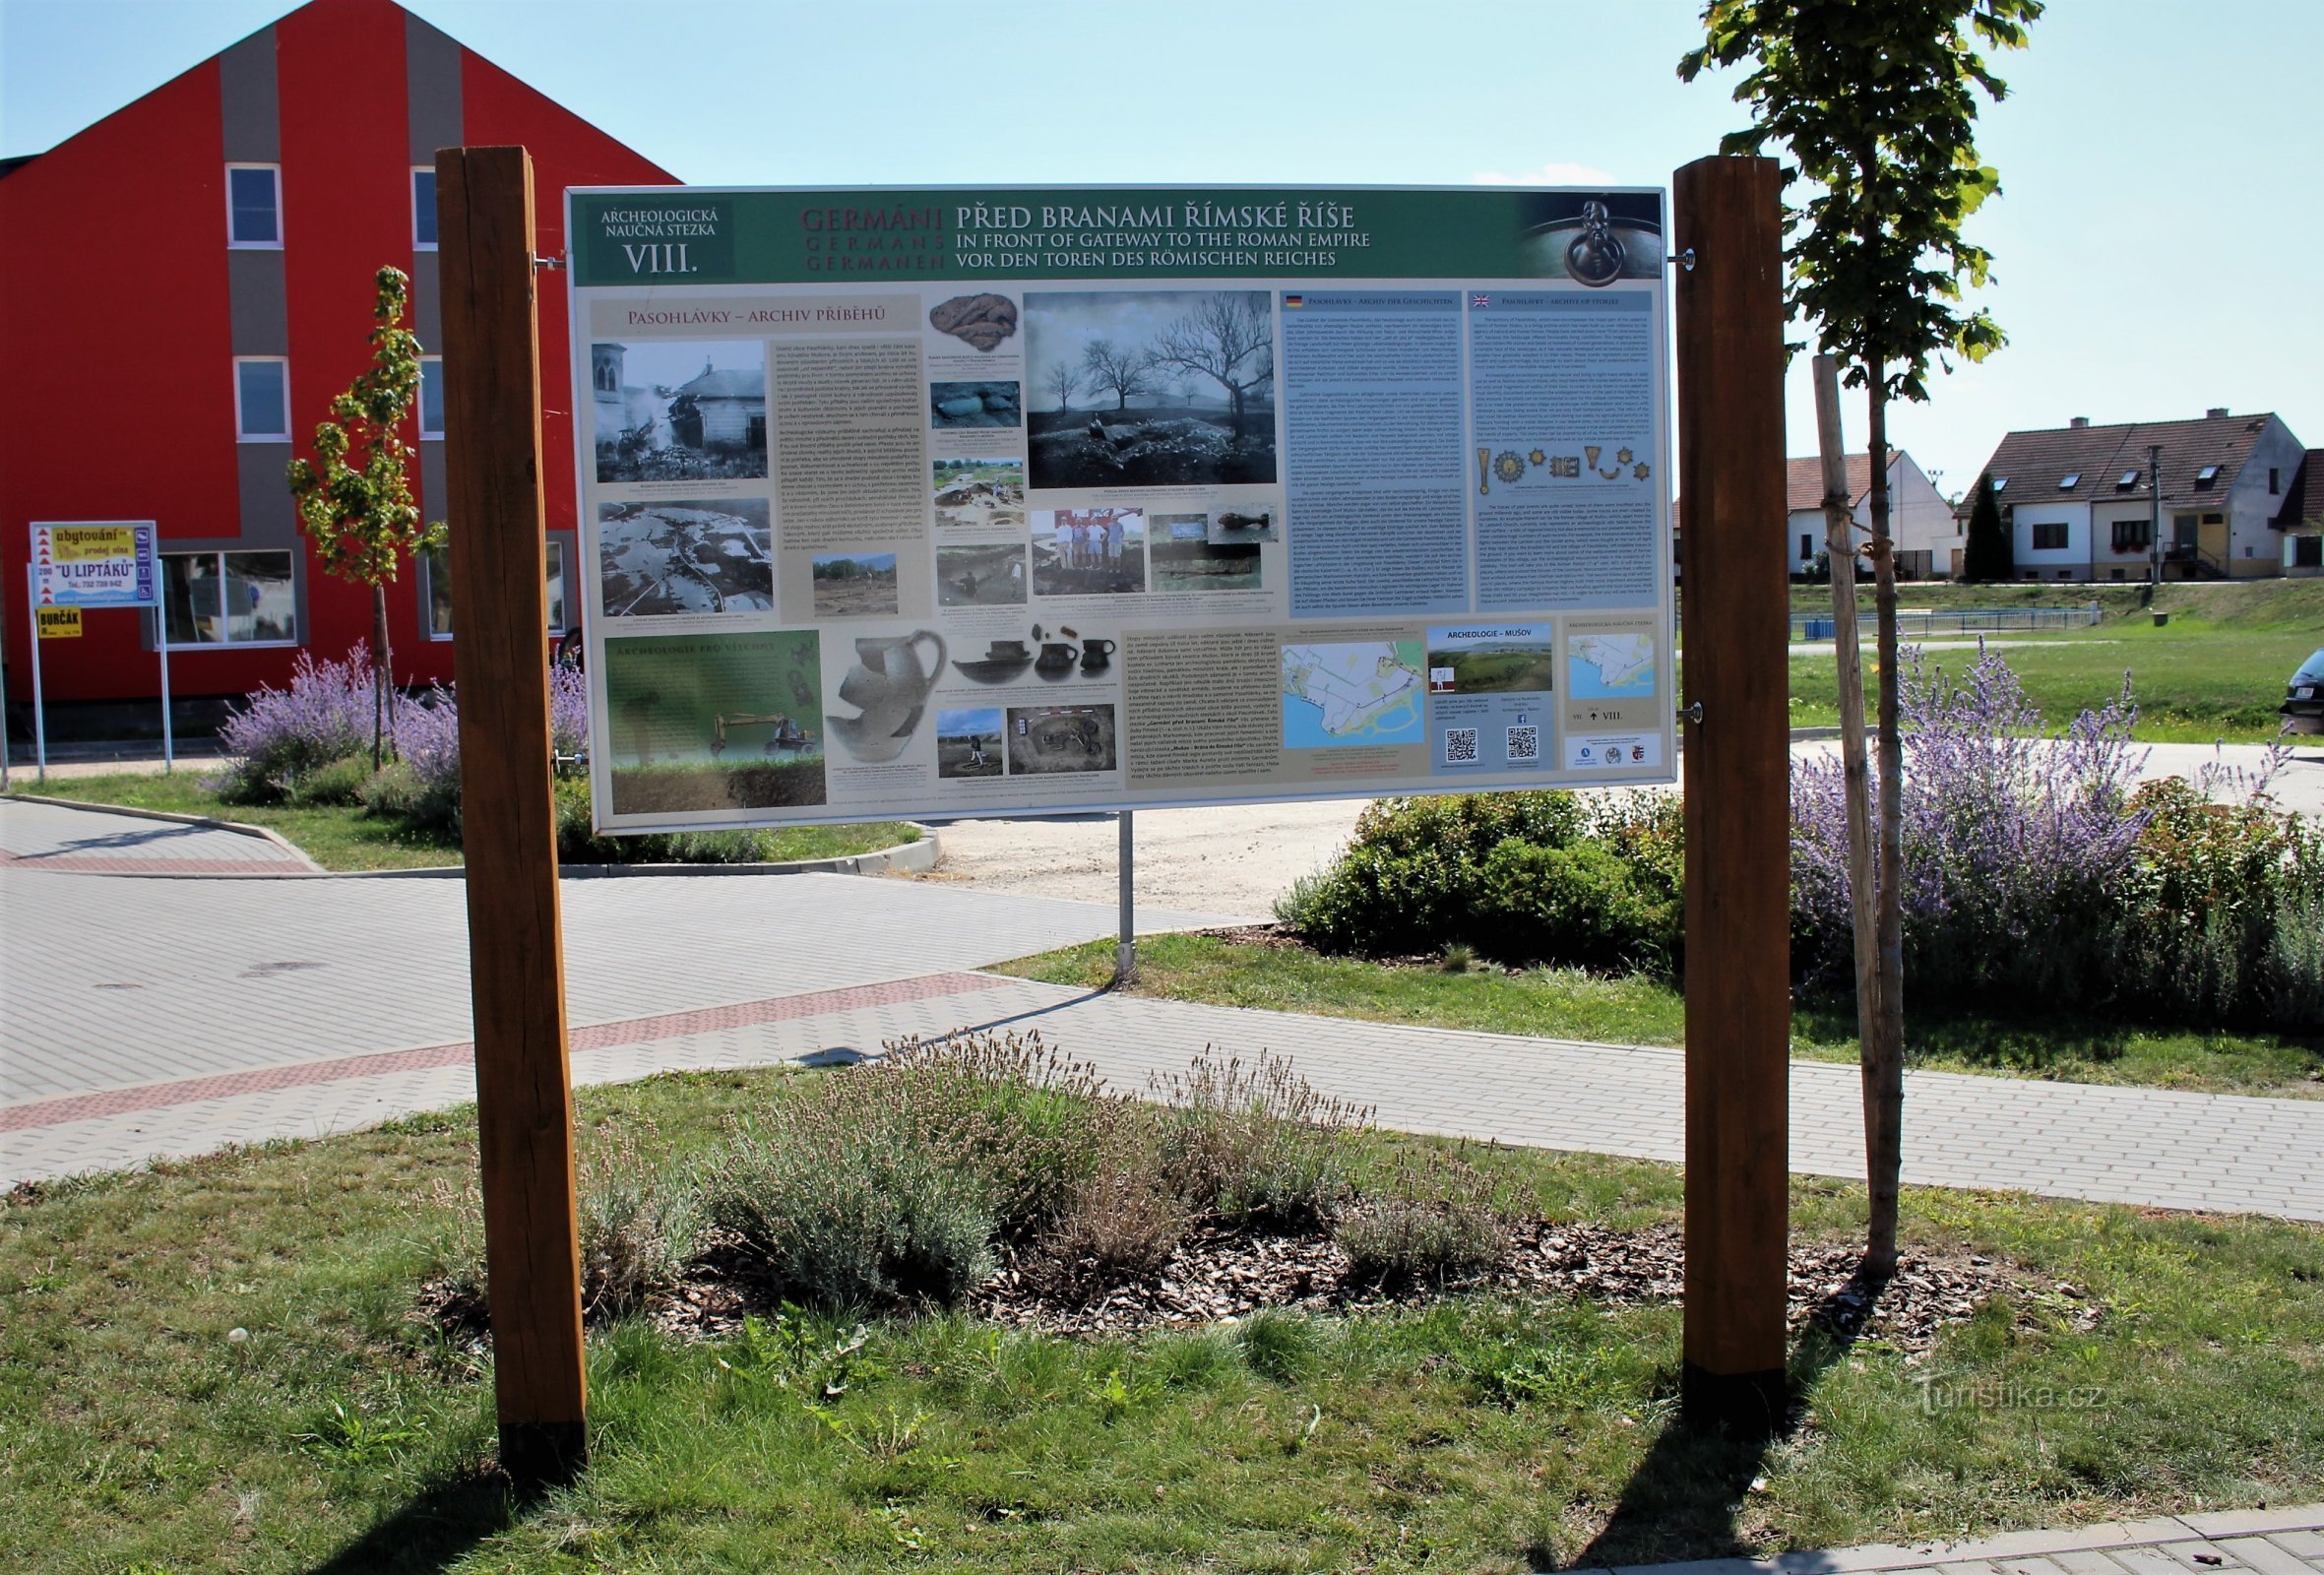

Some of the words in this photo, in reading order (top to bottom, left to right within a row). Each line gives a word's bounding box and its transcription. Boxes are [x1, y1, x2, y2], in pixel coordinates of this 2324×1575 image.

[601, 207, 719, 223] ARCHEOLOGICKÁ
[799, 204, 942, 232] GERMÁNI
[956, 201, 1032, 229] PŘED
[1041, 206, 1175, 229] BRANAMI
[1184, 201, 1288, 228] ŘÍMSKÉ
[1297, 201, 1355, 228] ŘÍŠE
[605, 222, 664, 237] NAUČNÁ
[667, 223, 716, 236] STEZKA
[804, 235, 945, 251] GERMANS
[956, 234, 977, 248] IN
[984, 233, 1045, 248] FRONT
[1050, 233, 1075, 247] OF
[1079, 232, 1163, 247] GATEWAY
[1167, 232, 1192, 247] TO
[1192, 232, 1231, 246] THE
[1237, 232, 1303, 246] ROMAN
[1308, 232, 1371, 247] EMPIRE
[621, 243, 698, 274] VIII.
[805, 255, 945, 272] GERMANEN
[955, 253, 994, 268] VOR
[1000, 253, 1038, 267] DEN
[1043, 252, 1105, 267] TOREN
[1111, 252, 1145, 267] DES
[1150, 248, 1258, 266] RÖMISCHEN
[1264, 251, 1337, 266] REICHES
[40, 609, 79, 626] BURČÁK
[1505, 628, 1532, 637] MUŠOV
